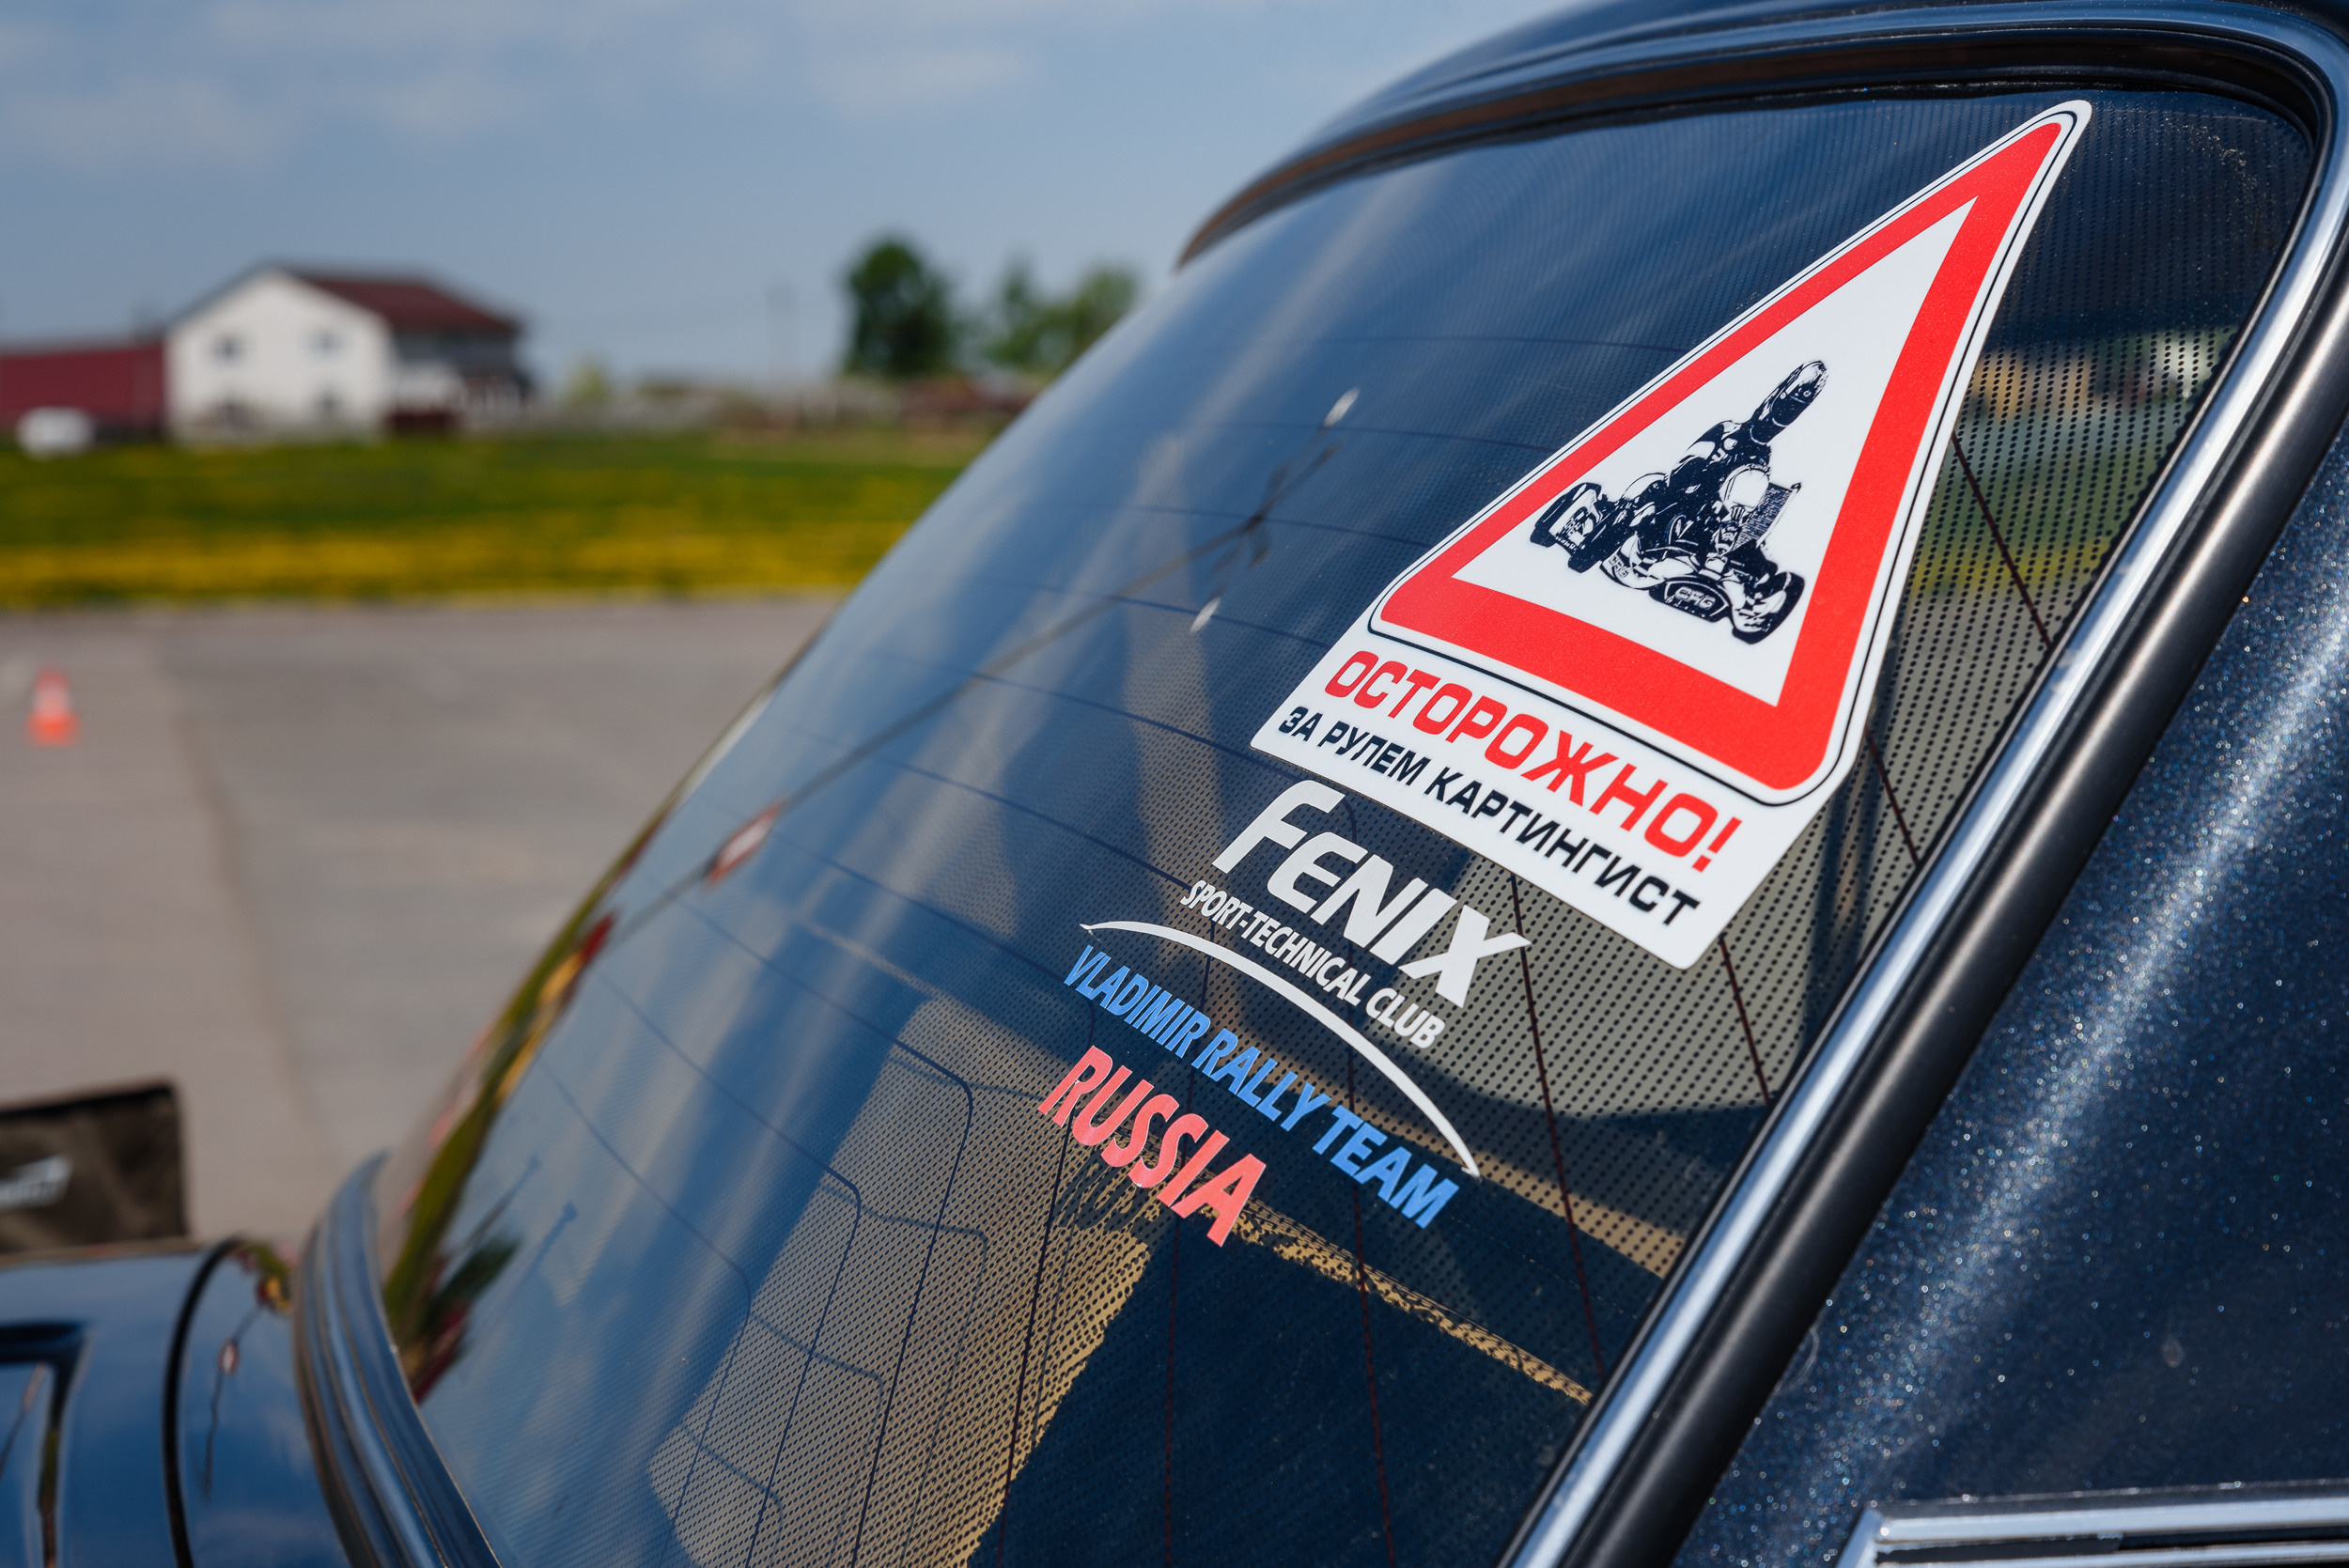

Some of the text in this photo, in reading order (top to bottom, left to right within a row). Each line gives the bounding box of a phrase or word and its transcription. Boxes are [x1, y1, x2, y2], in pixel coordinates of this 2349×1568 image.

[1278, 706, 1700, 925] ЗА РУЛЕМ КАРТИНГИСТ
[1324, 650, 1742, 873] ОСТОРОЖНО!
[1180, 879, 1446, 1049] SPORT-TECHNICAL CLUB
[1211, 780, 1532, 1008] FENIX
[1036, 1045, 1268, 1248] RUSSIA
[1063, 944, 1461, 1230] VLADIMIR RALLY TEAM
